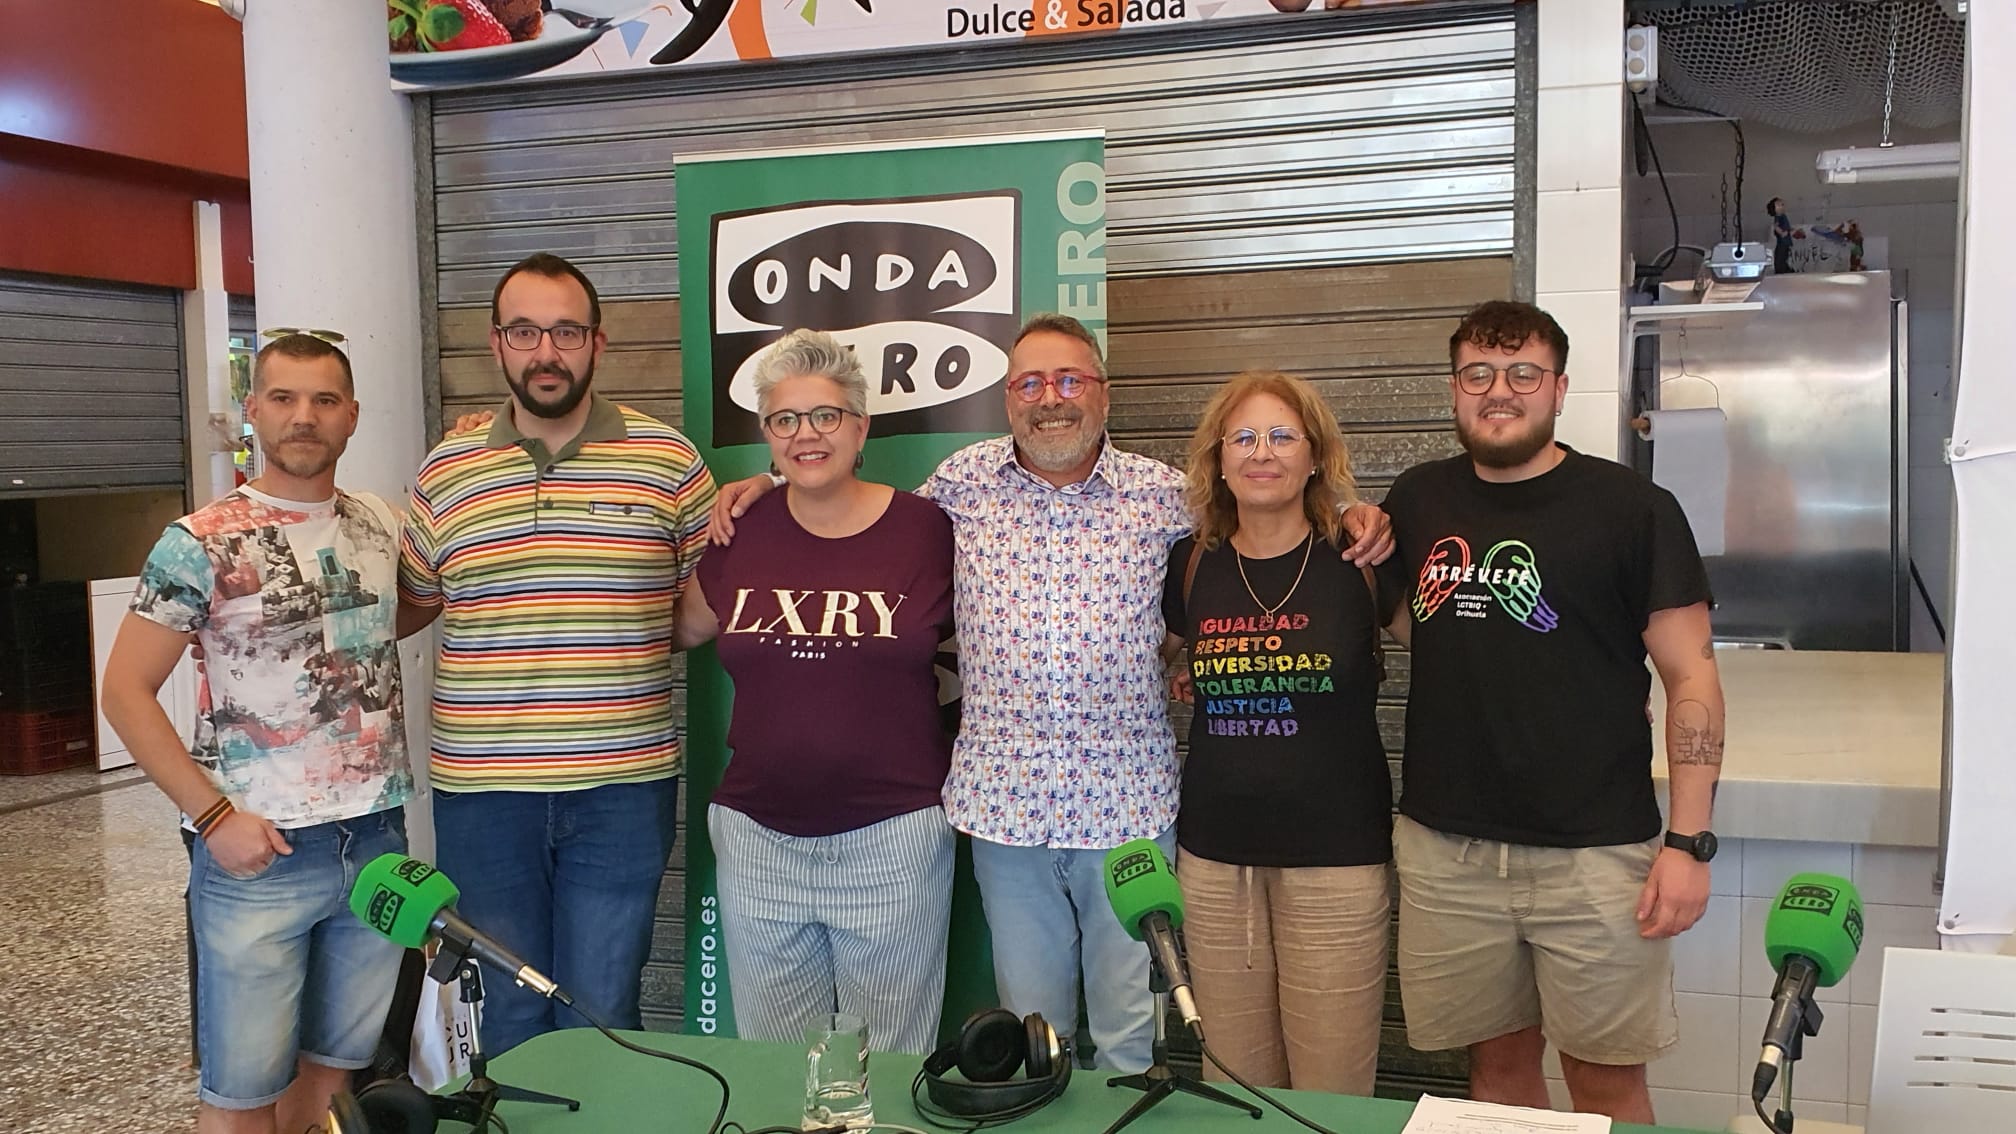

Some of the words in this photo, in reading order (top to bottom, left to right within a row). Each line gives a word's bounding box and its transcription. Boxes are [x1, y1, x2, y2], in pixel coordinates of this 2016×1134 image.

[947, 3, 1036, 38] Dulce
[1044, 0, 1069, 30] &
[1077, 0, 1186, 27] Salada
[1056, 161, 1108, 363] ERO
[753, 249, 969, 305] ONDA
[848, 341, 971, 396] RO
[1427, 563, 1531, 586] ATRÉVETE
[724, 588, 908, 639] LXRY
[1199, 613, 1310, 636] IGUALDAD
[1456, 609, 1487, 619] Orihuela
[759, 636, 860, 649] FASHION
[1194, 635, 1282, 656] RESPETO
[791, 650, 826, 660] PARIS
[1193, 653, 1333, 678] DIVERSIDAD
[1195, 676, 1336, 697] TOLERANCIA
[1206, 697, 1295, 716] JUSTICIA
[1207, 718, 1300, 738] LIBERTAD
